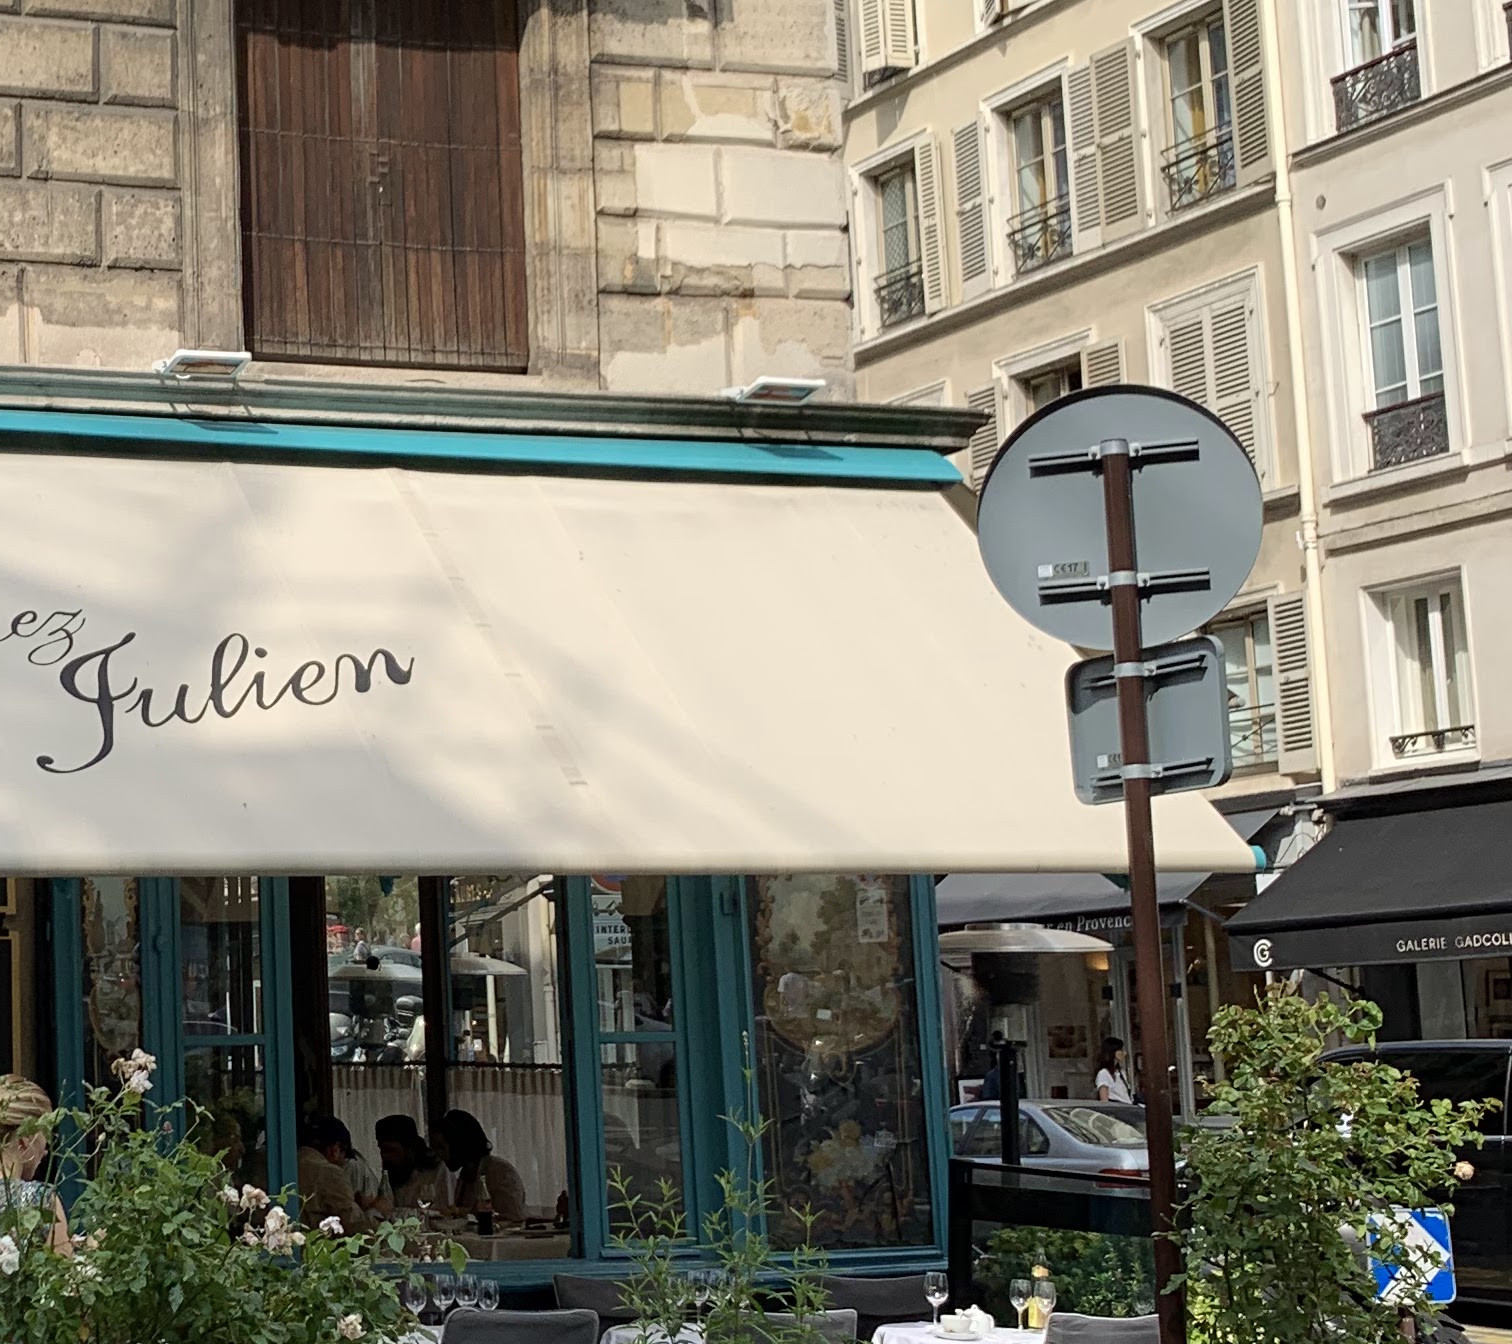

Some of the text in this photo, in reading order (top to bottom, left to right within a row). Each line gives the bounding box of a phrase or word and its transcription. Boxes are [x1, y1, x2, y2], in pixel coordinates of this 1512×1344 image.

[35, 631, 415, 774] Julien
[1076, 915, 1133, 932] Provenc
[1395, 937, 1448, 953] GALERIE
